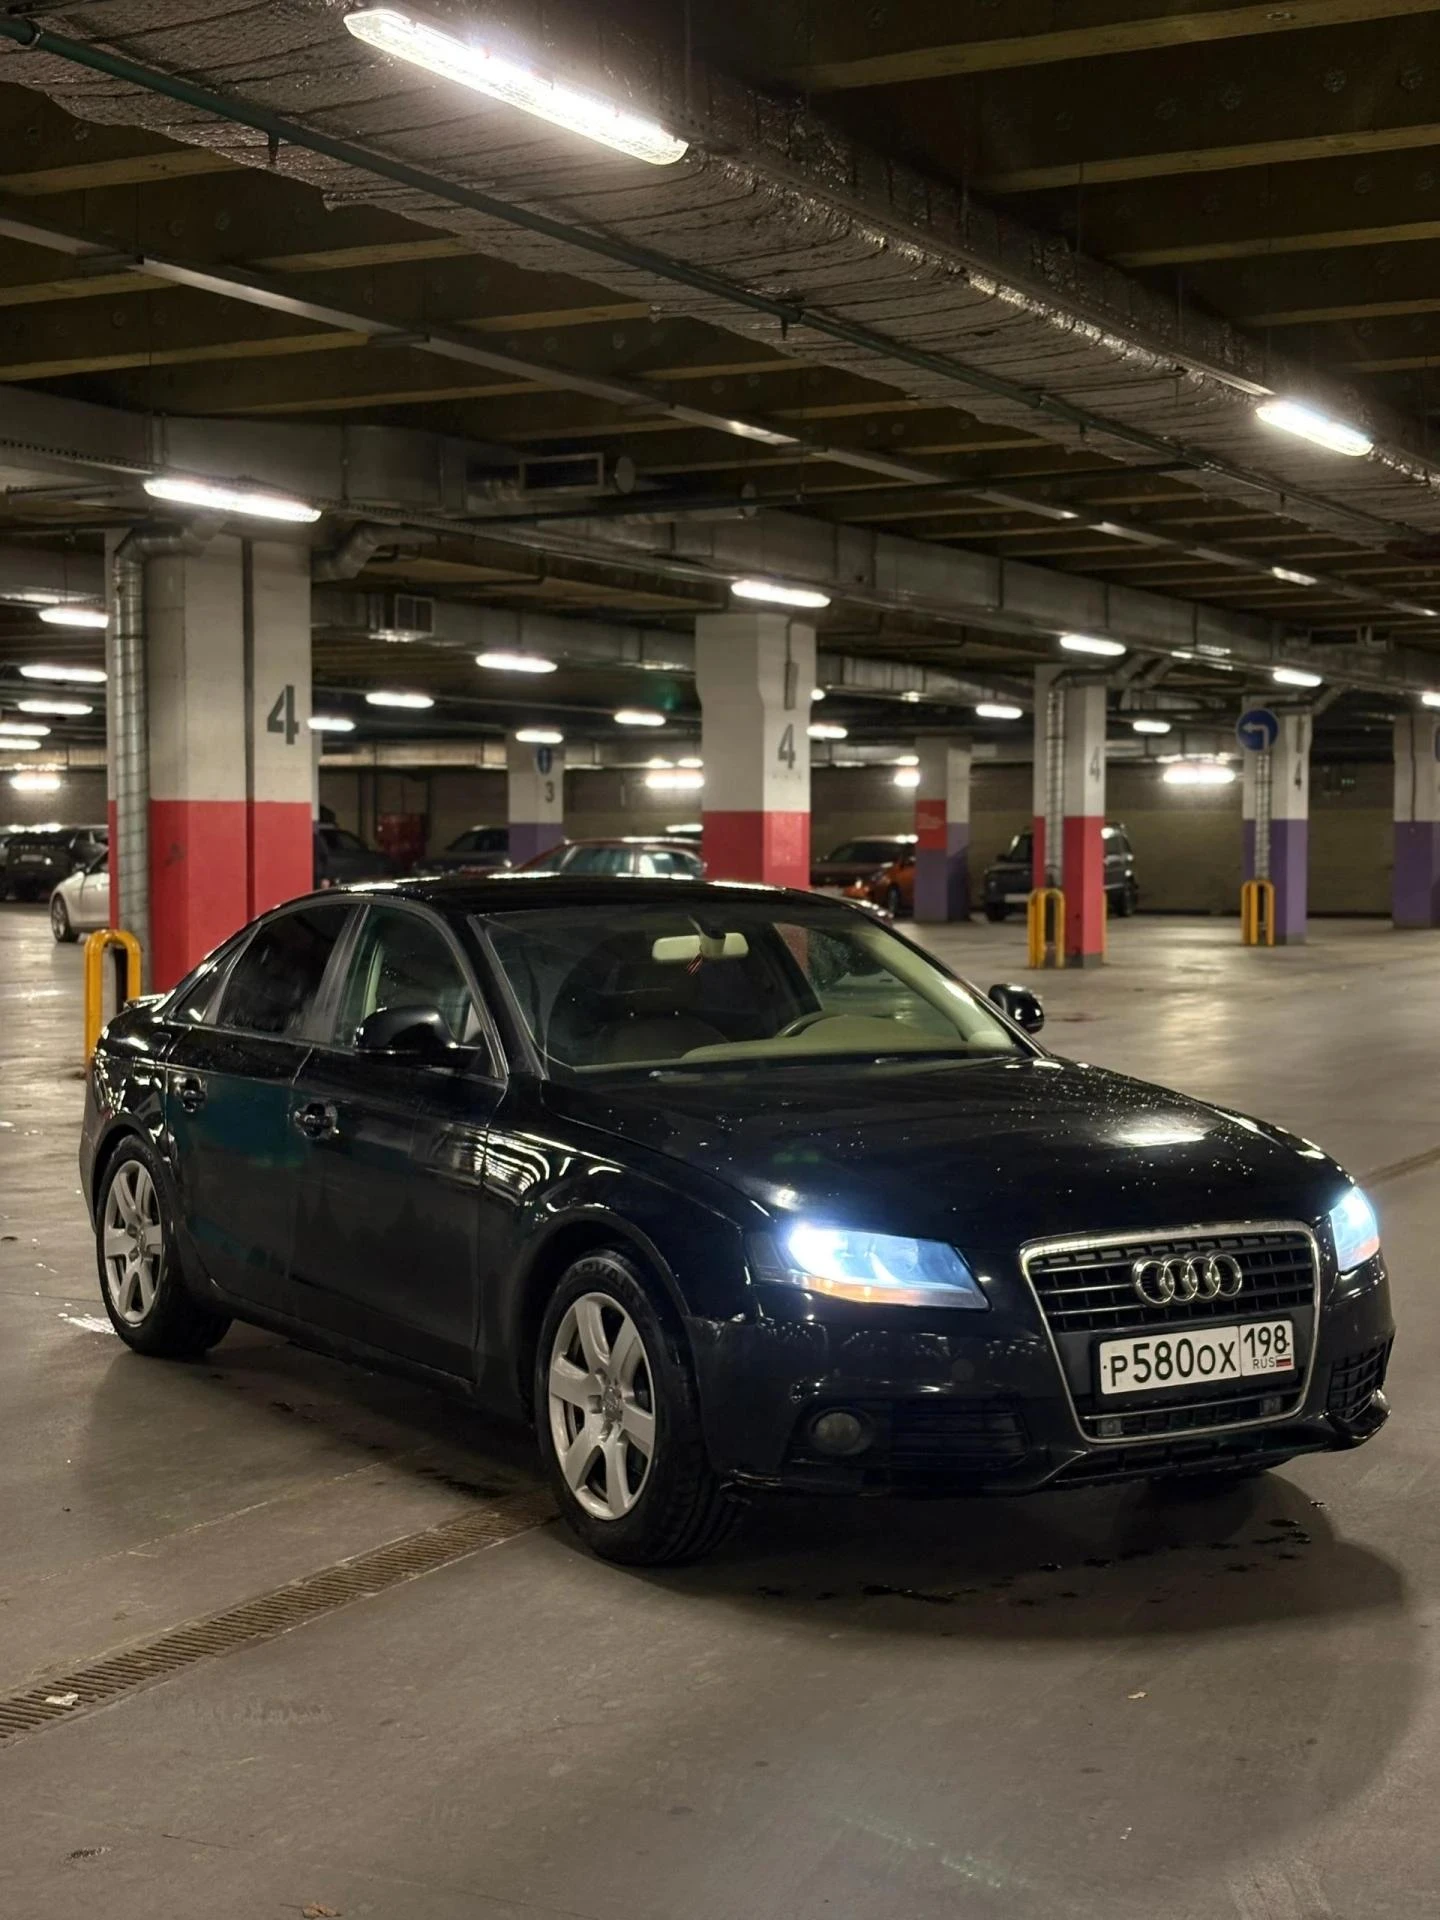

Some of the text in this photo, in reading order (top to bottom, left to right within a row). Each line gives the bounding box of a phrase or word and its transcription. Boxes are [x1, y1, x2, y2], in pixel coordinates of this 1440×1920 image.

[266, 684, 299, 745] 4
[778, 723, 795, 769] 4
[1089, 746, 1101, 783] 4
[545, 781, 555, 803] 3
[1243, 1324, 1287, 1358] 198
[1252, 1356, 1275, 1370] RUS
